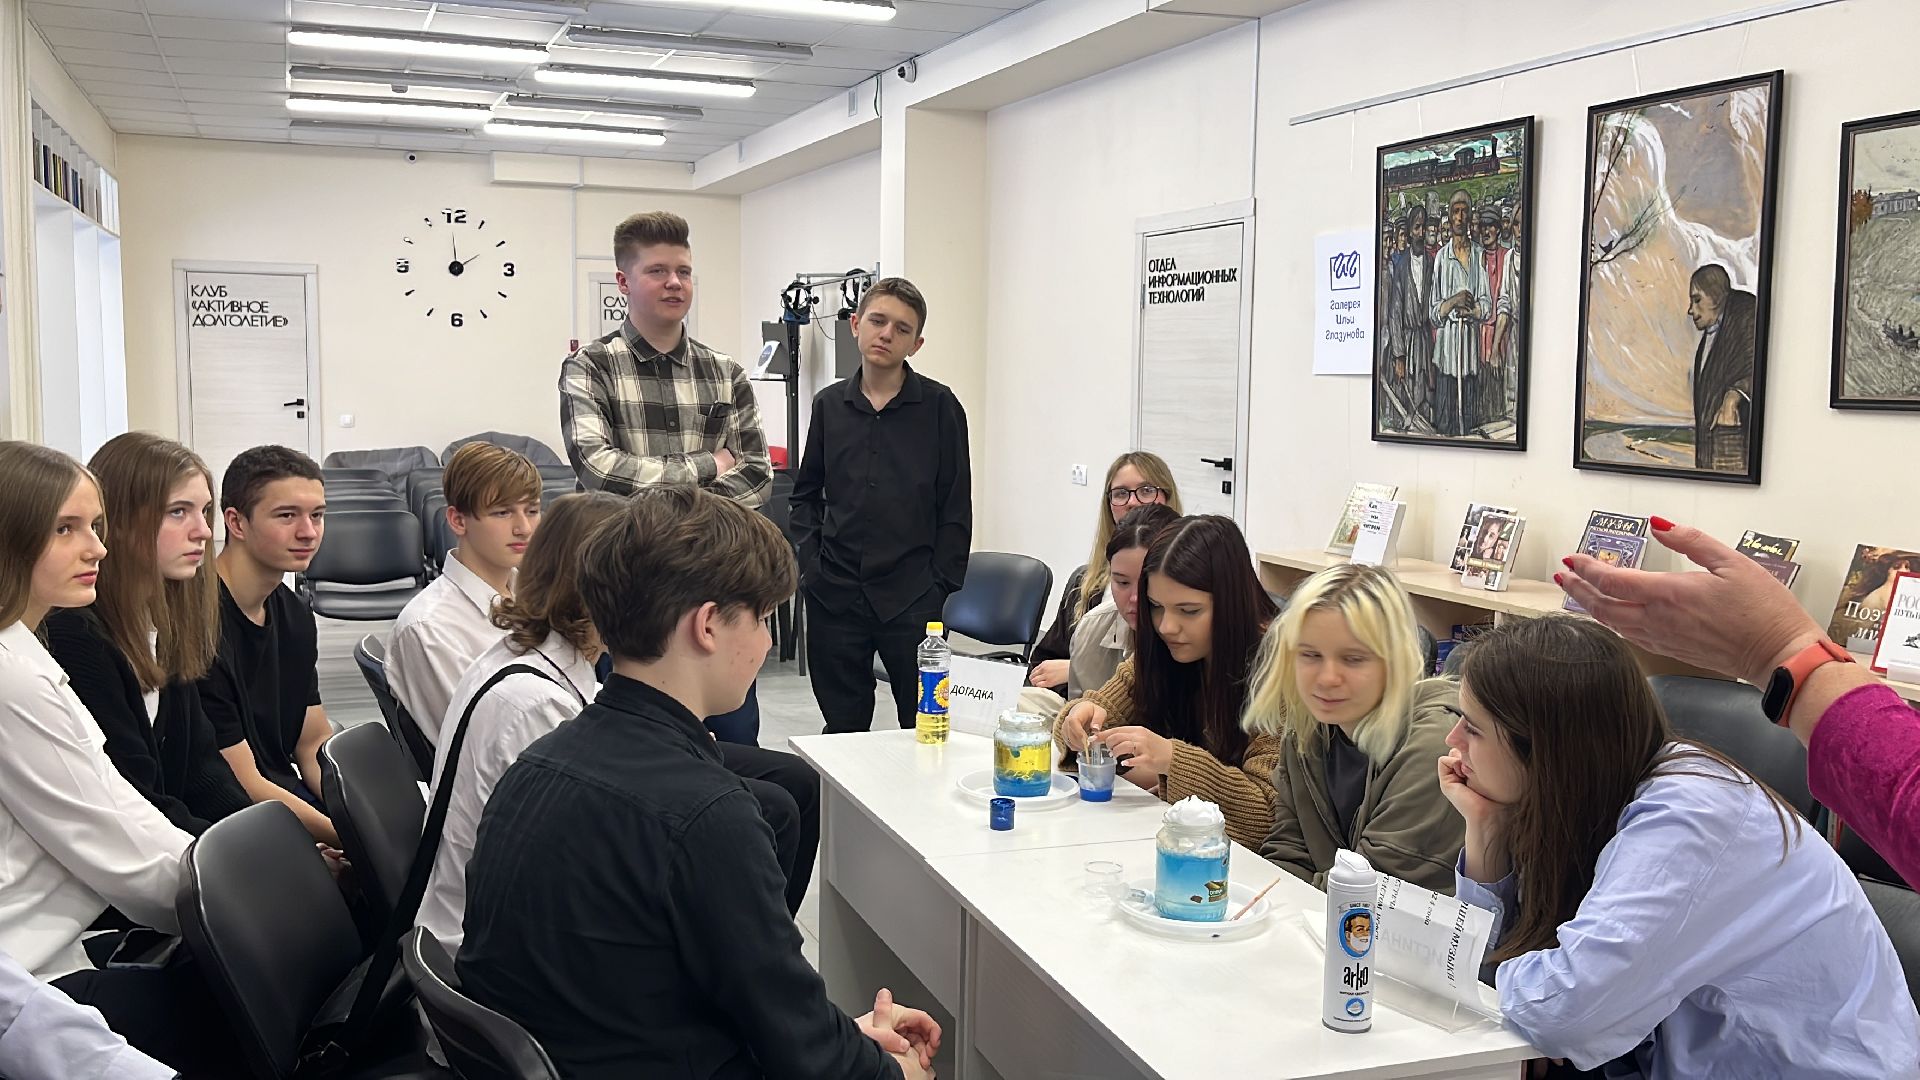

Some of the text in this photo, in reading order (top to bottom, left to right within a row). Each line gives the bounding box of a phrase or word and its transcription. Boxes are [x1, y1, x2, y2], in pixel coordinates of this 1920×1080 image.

[441, 208, 467, 224] 12
[503, 262, 515, 277] 3
[1148, 258, 1176, 273] ОТДЕЛ
[1148, 268, 1237, 289] ИНФОРМАЦИОННЫХ
[191, 284, 228, 298] КЛУБ
[1148, 286, 1205, 304] ТЕХНОЛОГИЙ
[191, 299, 269, 314] «АКТИВНОЕ
[1329, 299, 1361, 313] Галерея
[192, 313, 289, 328] ДОЛГОЛЕТИЕ»
[450, 312, 464, 327] 6
[1325, 327, 1365, 343] Глазунова
[1844, 600, 1886, 622] Поэ
[950, 684, 994, 701] ДОГАДКА
[1446, 932, 1461, 982] МУЗЫКИ
[1343, 962, 1369, 991] arko
